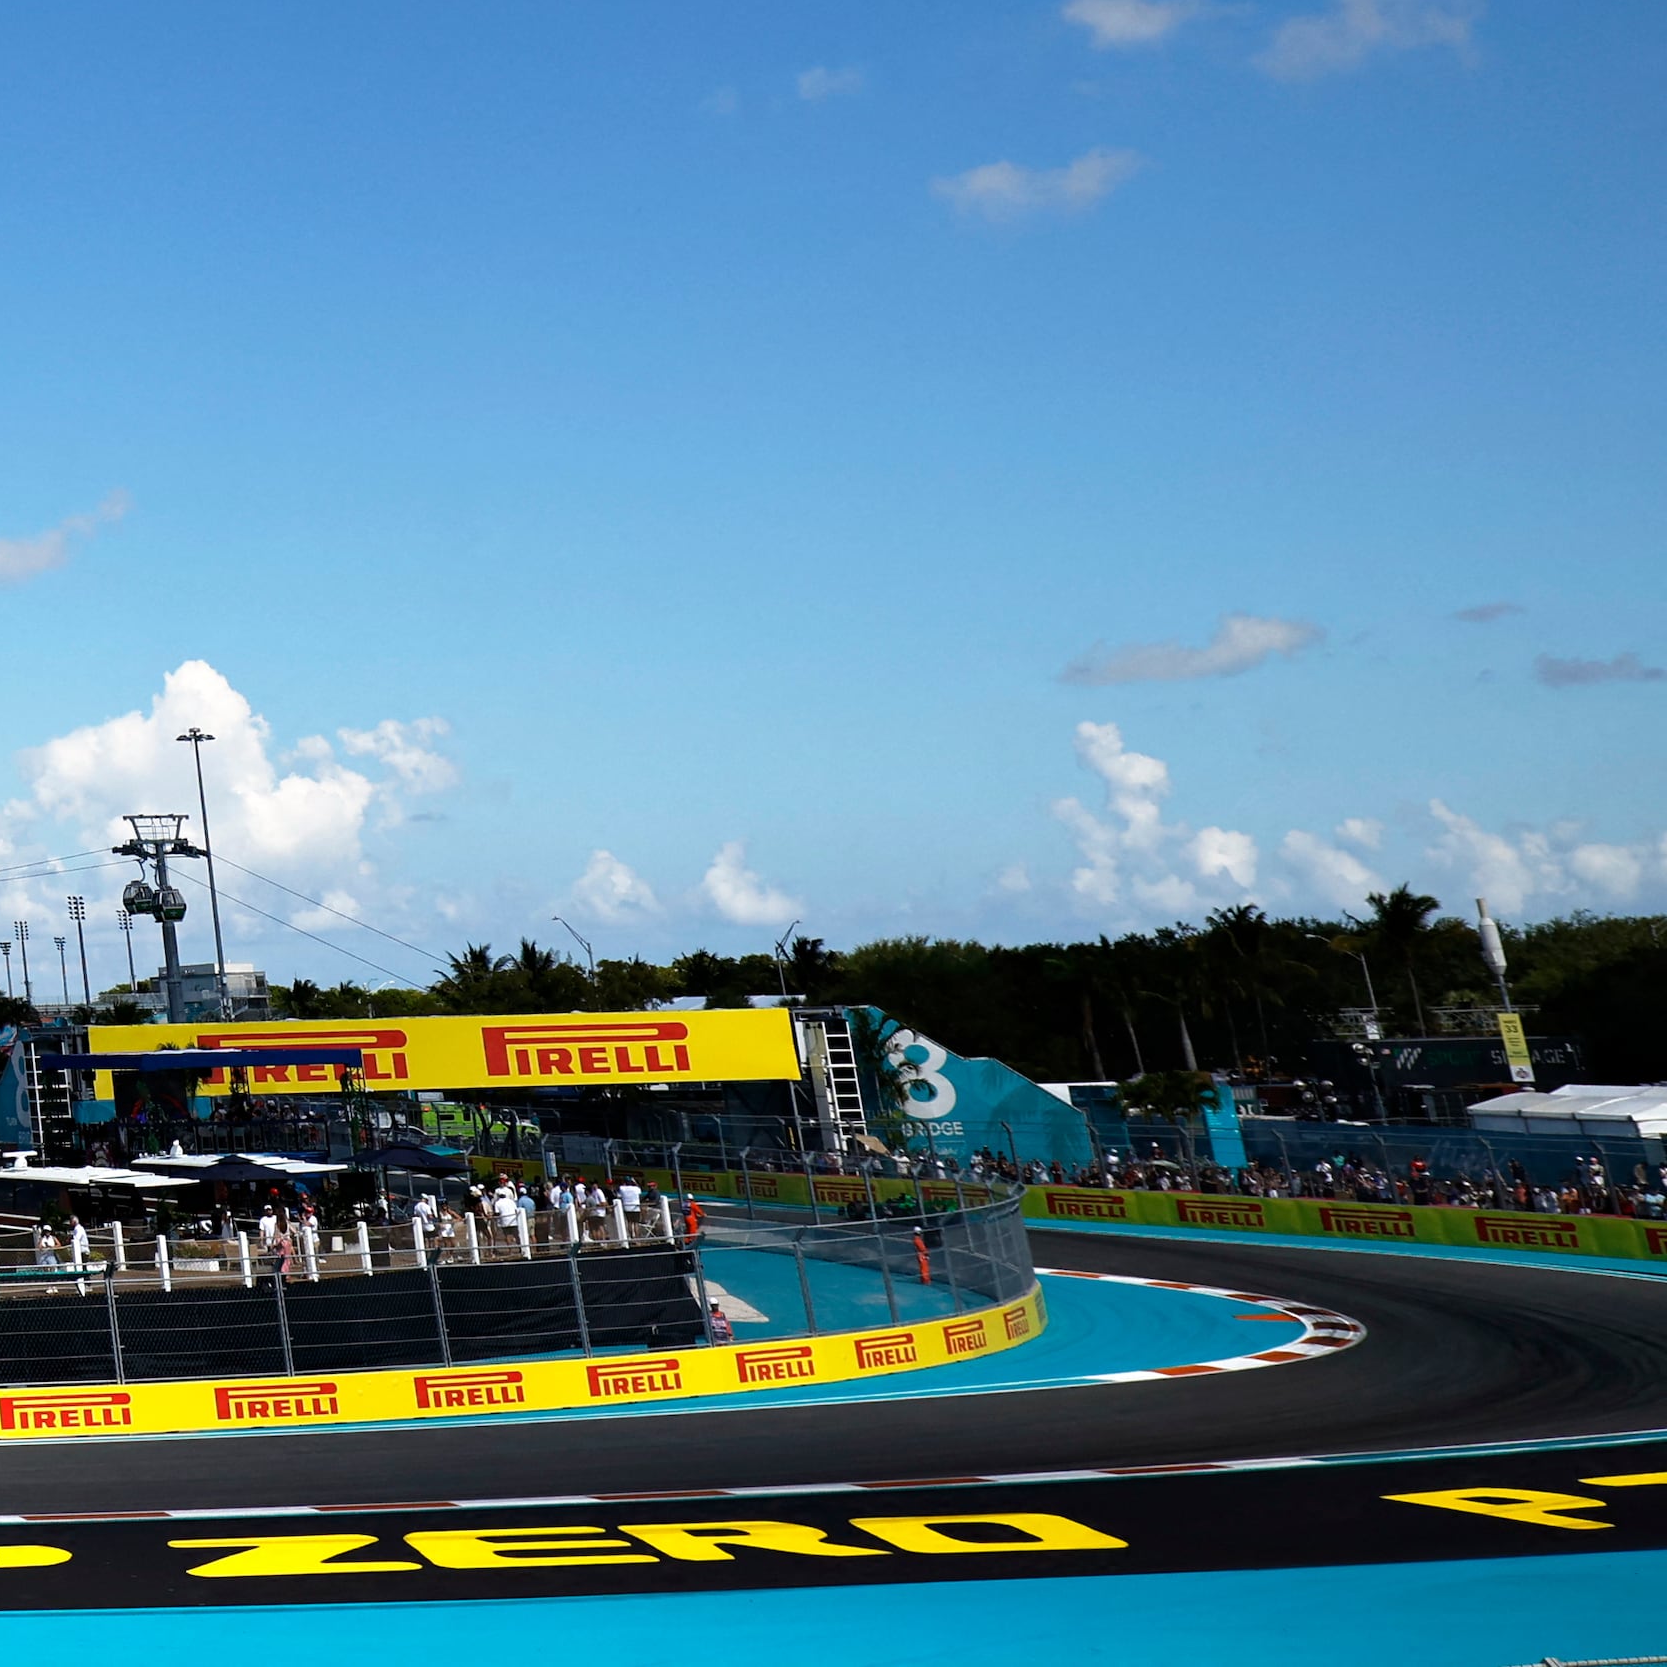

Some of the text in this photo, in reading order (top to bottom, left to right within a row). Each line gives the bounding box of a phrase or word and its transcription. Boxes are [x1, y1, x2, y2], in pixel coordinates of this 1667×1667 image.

[1505, 1025, 1518, 1034] 33
[481, 1022, 691, 1076] PIRELLI
[1045, 1192, 1127, 1218] PIRELLI
[1177, 1199, 1265, 1228] PIRELLI
[1319, 1208, 1415, 1237] PIRELLI
[1475, 1216, 1579, 1248] PIRELLI
[854, 1332, 917, 1370] PIRELLI
[943, 1319, 987, 1356] PIRELLI
[586, 1358, 683, 1398] PIRELLI
[735, 1346, 816, 1384] PIRELLI
[215, 1382, 339, 1420] PIRELLI
[413, 1370, 526, 1409] PIRELLI
[0, 1392, 132, 1430] PIRELLI
[168, 1512, 1130, 1578] ZERO
